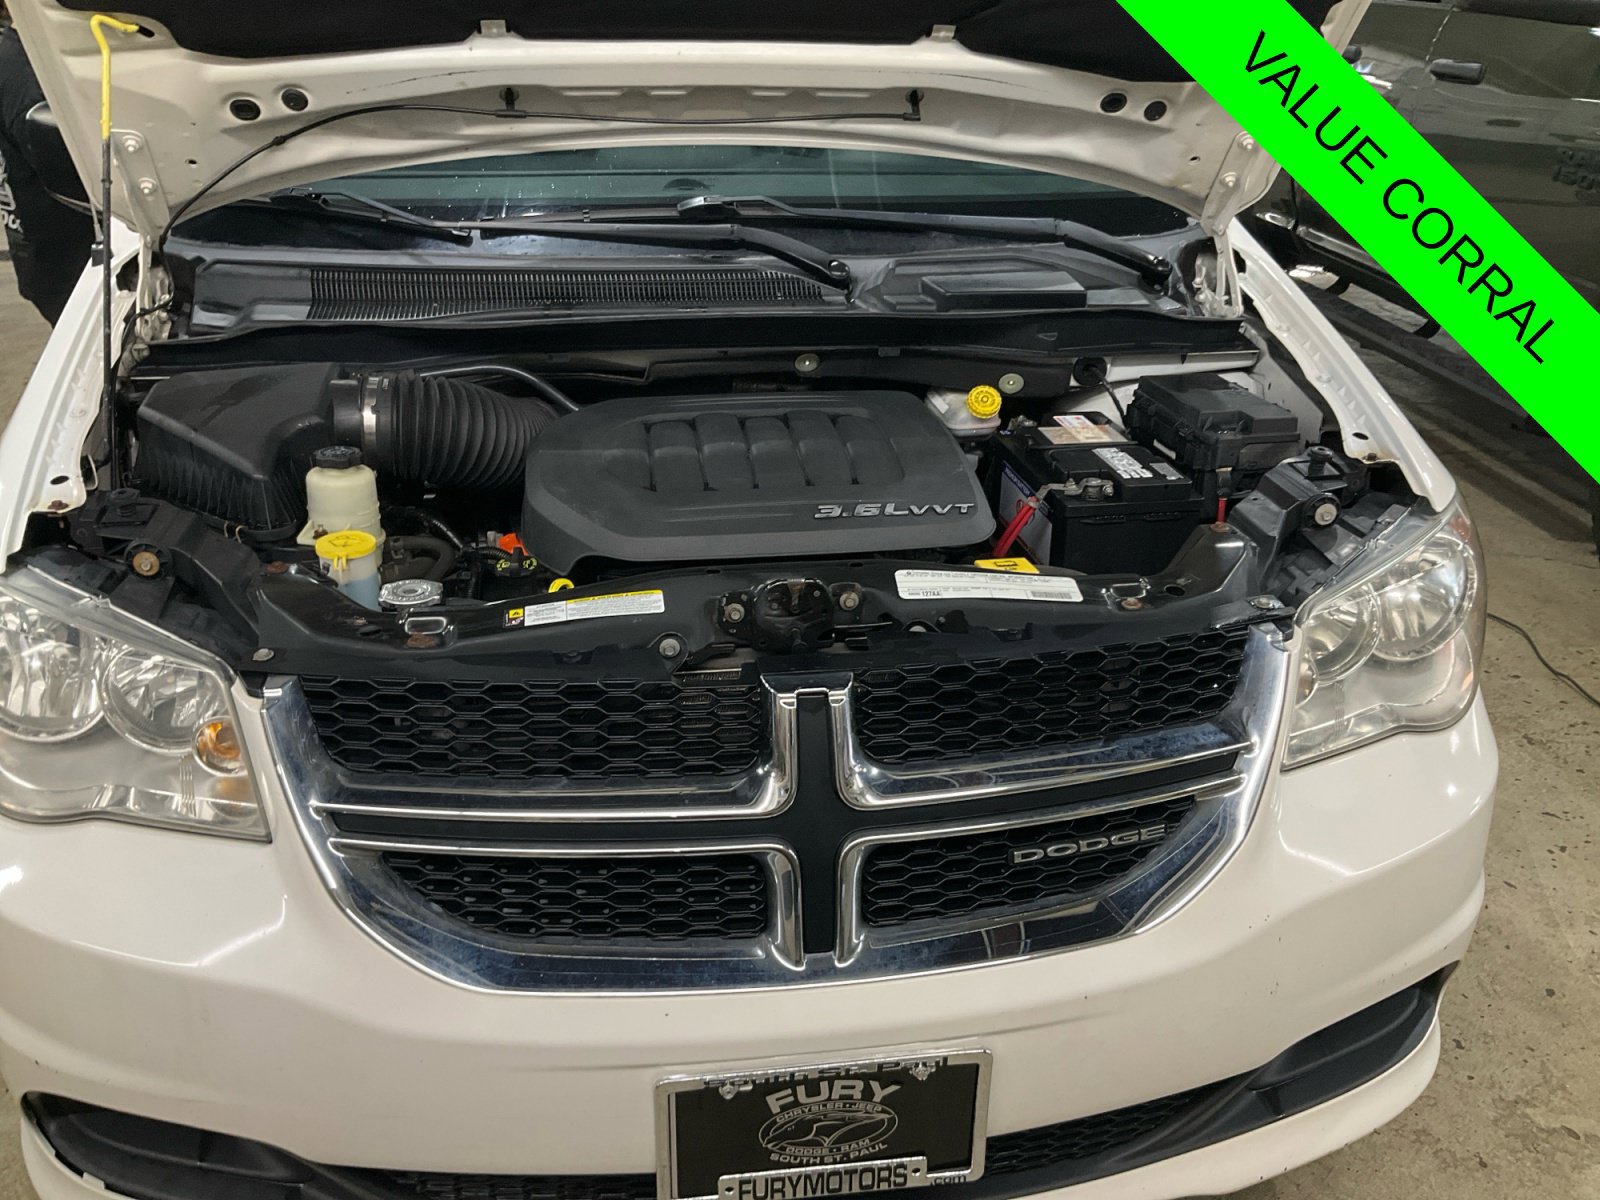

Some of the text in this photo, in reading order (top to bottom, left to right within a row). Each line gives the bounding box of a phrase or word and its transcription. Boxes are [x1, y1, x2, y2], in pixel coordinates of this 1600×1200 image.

[1013, 824, 1167, 864] DODGE
[765, 1079, 902, 1115] FURY
[769, 1152, 821, 1165] SOUTH
[849, 1142, 888, 1159] PAUL
[785, 1138, 871, 1155] DODGE RAM
